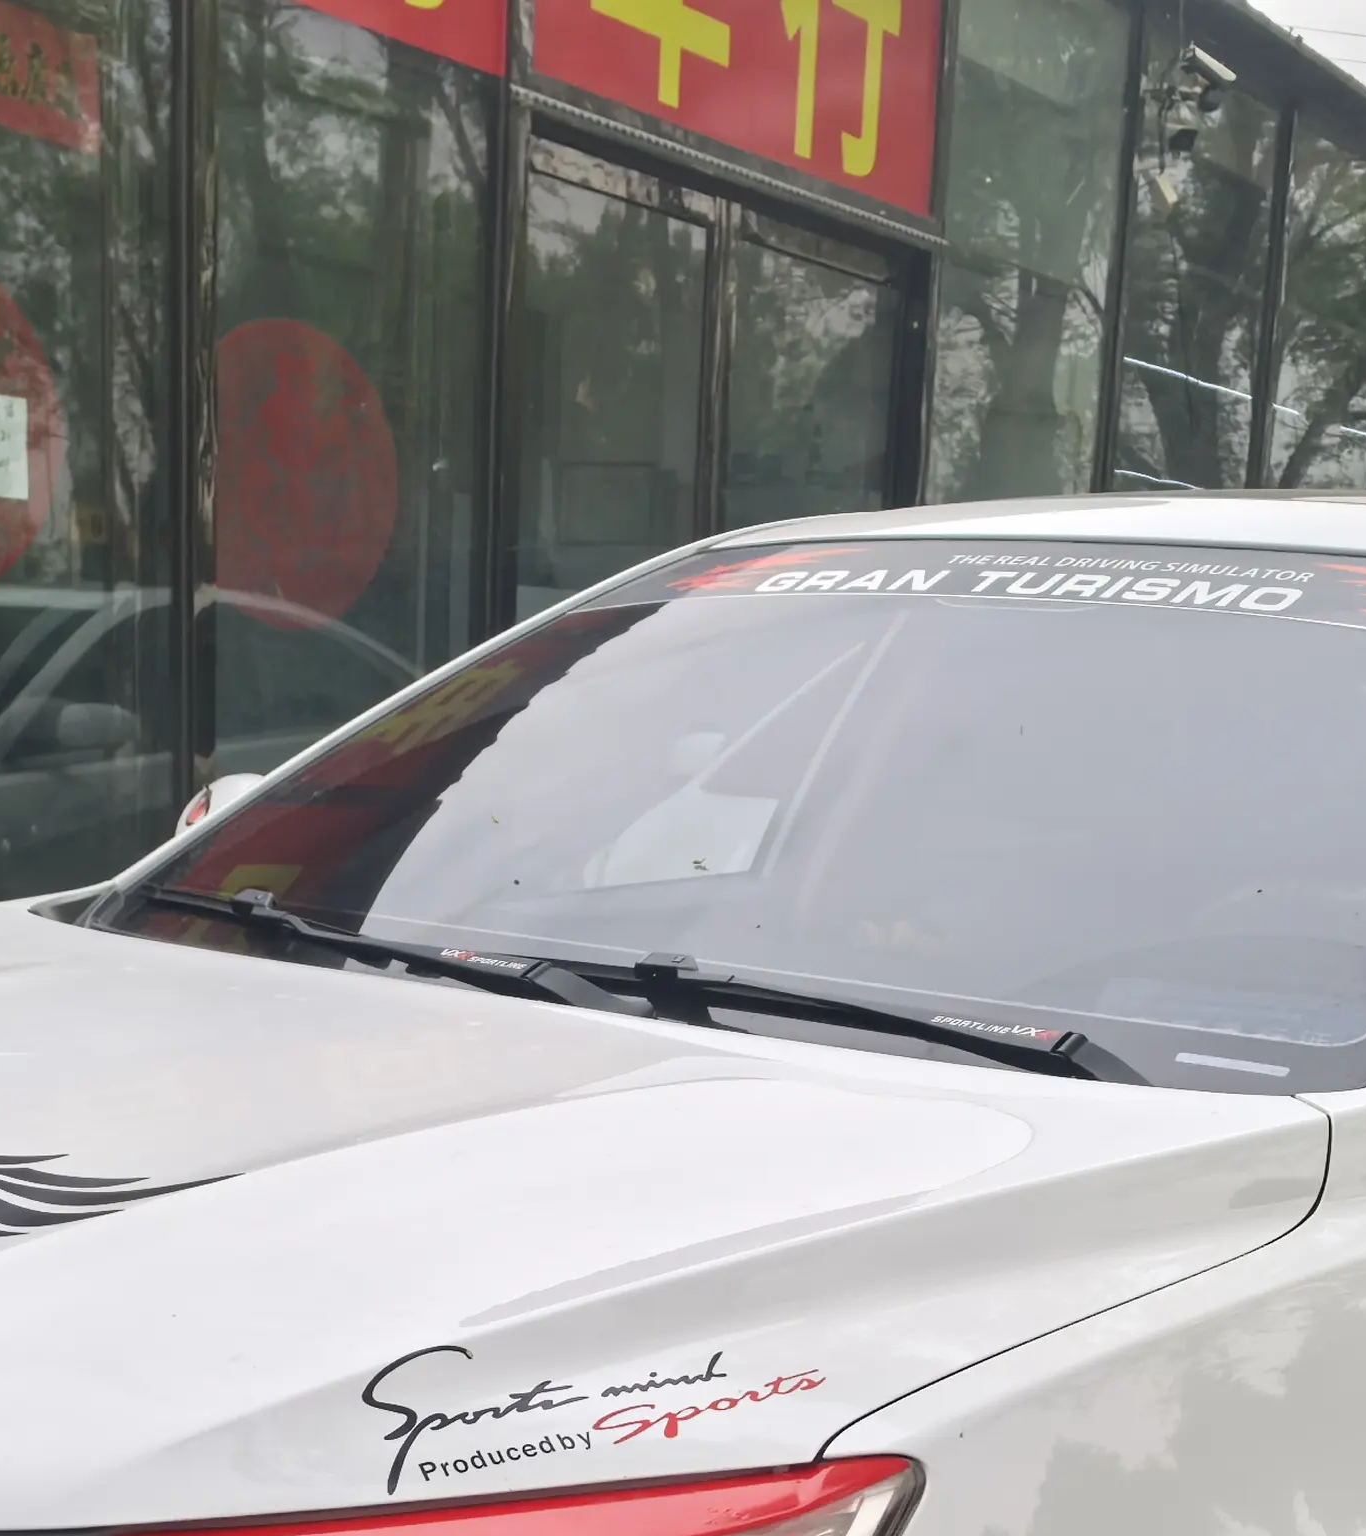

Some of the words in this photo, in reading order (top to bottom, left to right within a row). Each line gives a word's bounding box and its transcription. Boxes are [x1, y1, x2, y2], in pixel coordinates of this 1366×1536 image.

[947, 554, 992, 566] THE
[992, 555, 1050, 567] REAL
[1054, 556, 1162, 572] DRIVING
[1160, 561, 1315, 583] SIMULATOR
[754, 568, 952, 592] GRAN
[970, 569, 1303, 612] TURISMO
[467, 956, 528, 970] SPORTLINE
[931, 1015, 1013, 1034] SPORTLINE
[600, 1351, 727, 1398] mind
[591, 1368, 827, 1445] Sports
